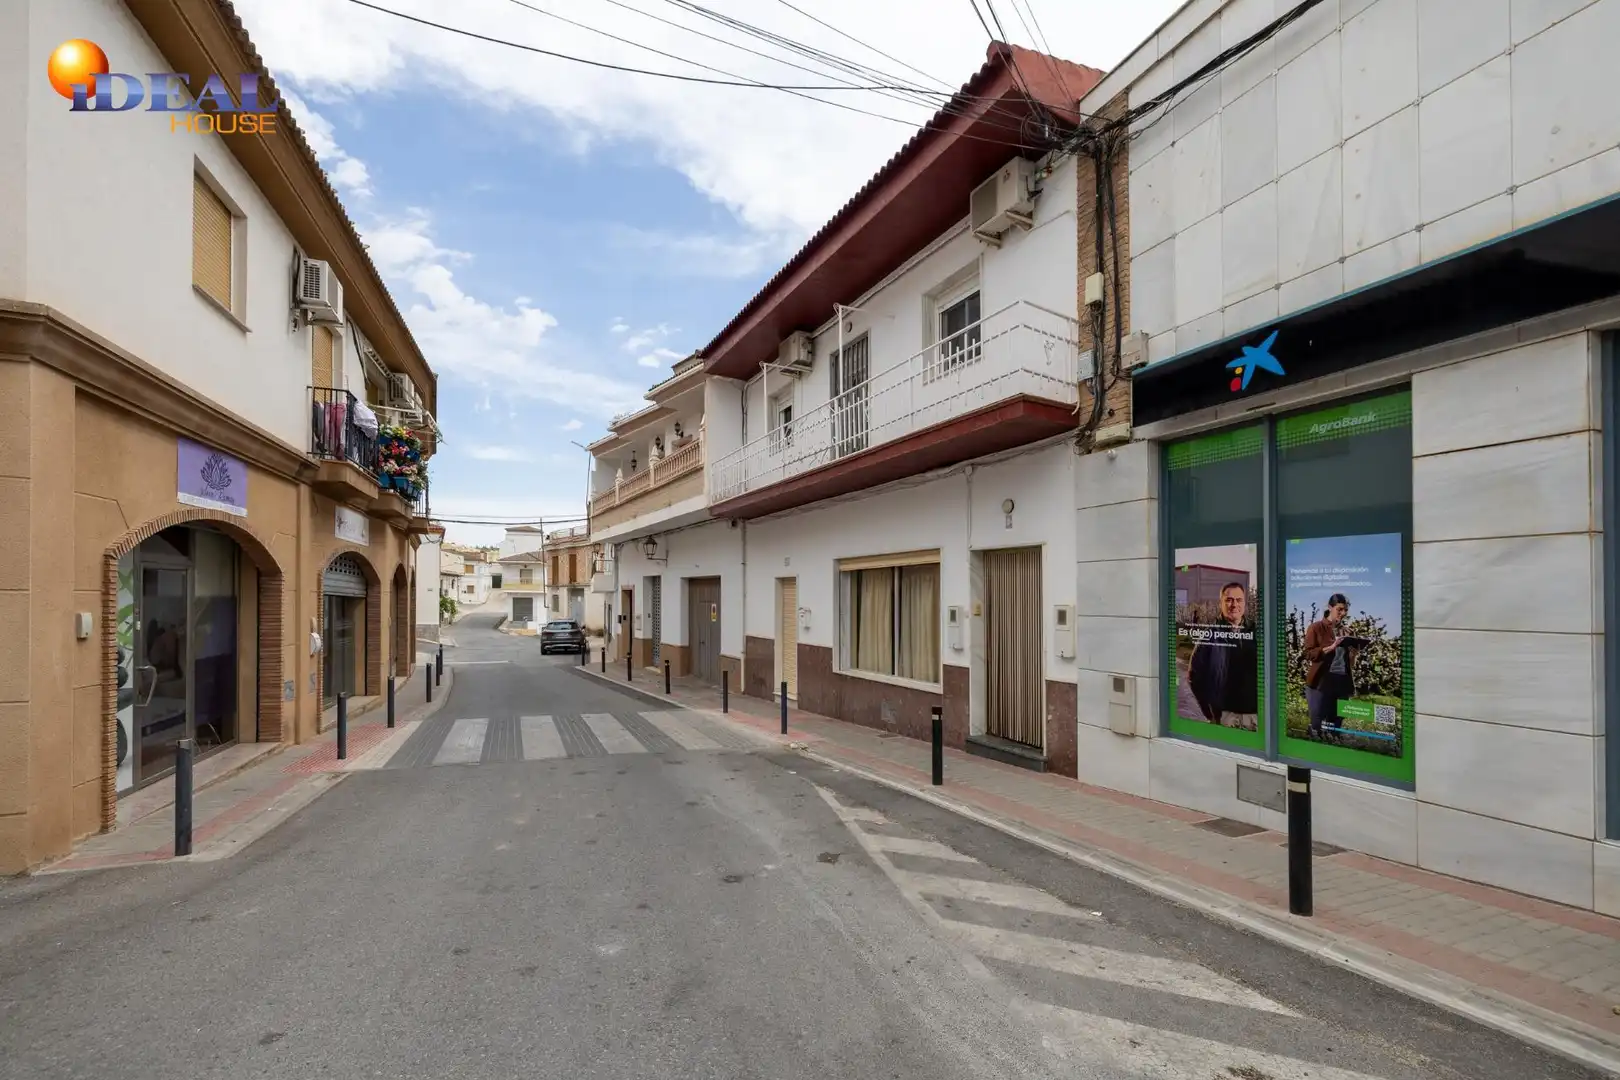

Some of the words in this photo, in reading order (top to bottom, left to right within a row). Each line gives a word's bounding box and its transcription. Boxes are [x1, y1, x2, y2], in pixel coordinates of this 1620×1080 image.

[1309, 412, 1377, 434] AgroBank
[1178, 627, 1188, 636] Es
[1189, 628, 1213, 638] (algo)
[1214, 631, 1254, 640] personal
